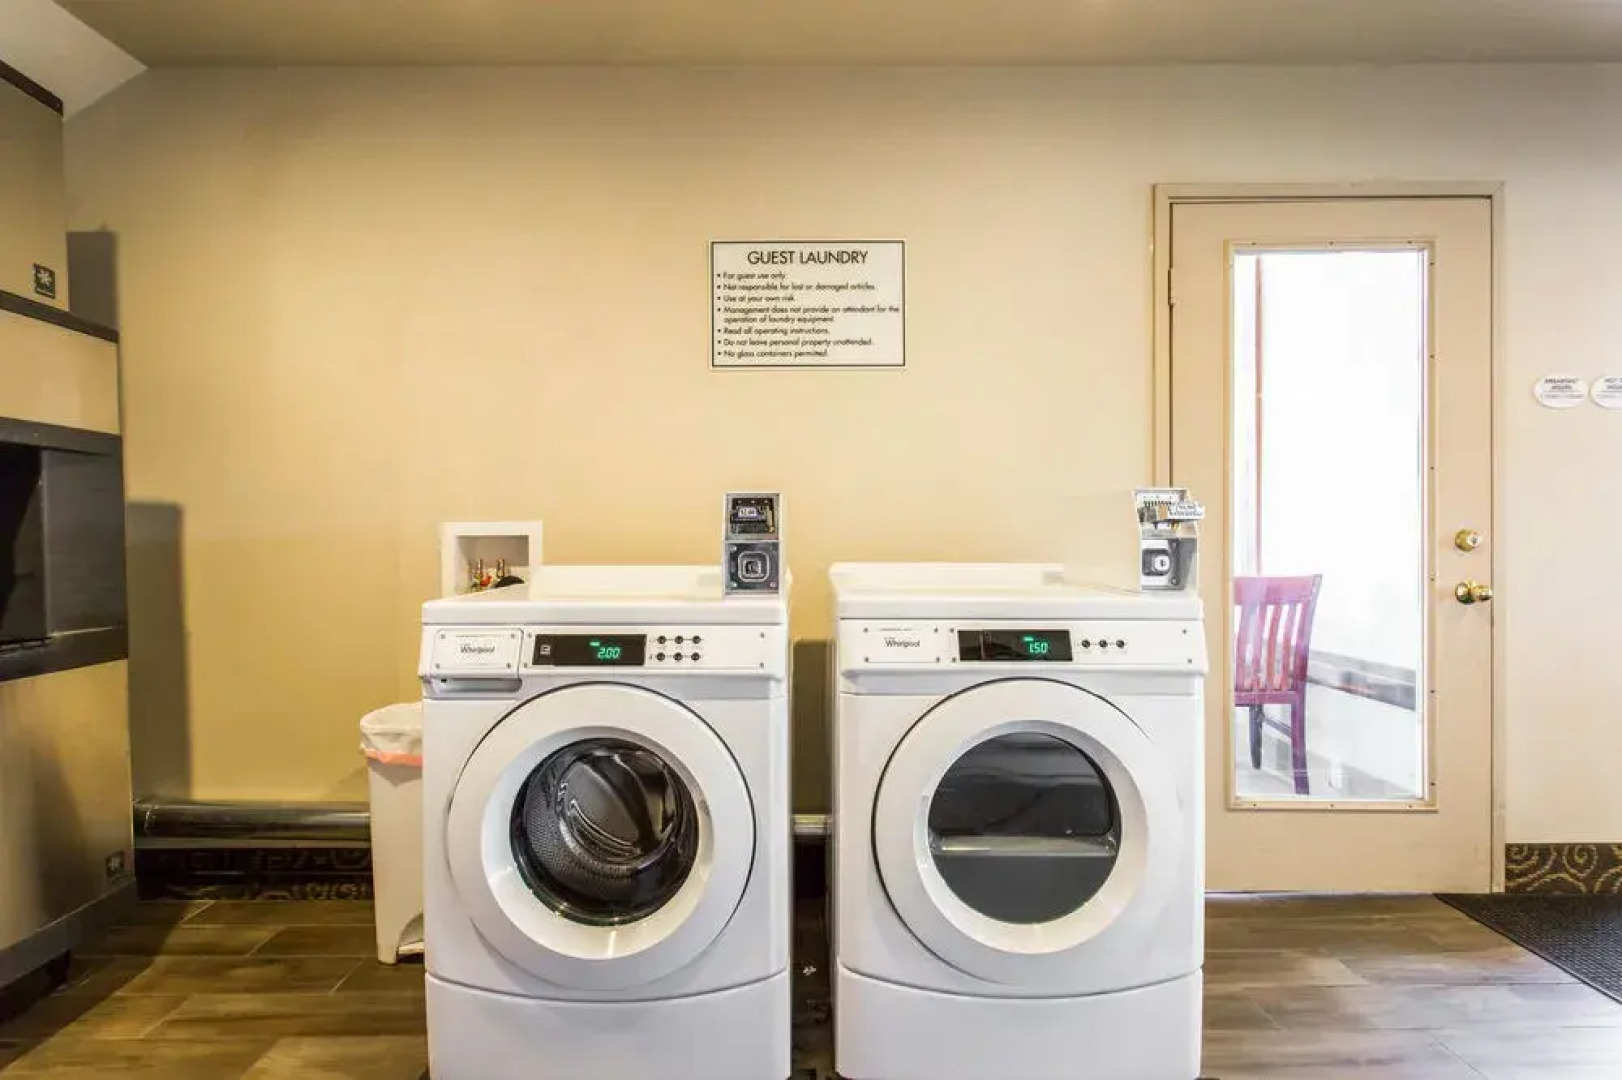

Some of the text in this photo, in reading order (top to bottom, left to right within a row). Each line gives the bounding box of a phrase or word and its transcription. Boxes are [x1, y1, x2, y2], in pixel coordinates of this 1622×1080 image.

[747, 250, 868, 265] GUEST LAUNDRY
[723, 271, 735, 279] For
[736, 272, 756, 281] guest
[723, 282, 737, 290] Not
[738, 282, 778, 292] responsible
[779, 282, 789, 290] for
[791, 282, 804, 290] lost
[815, 281, 849, 292] damaged
[723, 294, 736, 302] Use
[723, 306, 770, 315] Management
[771, 305, 788, 313] does
[802, 305, 829, 315] provide
[842, 305, 875, 313] attendant
[877, 304, 887, 313] for
[888, 305, 900, 313] the
[723, 317, 758, 325] operation
[758, 315, 767, 323] of
[769, 315, 796, 325] laundry
[723, 326, 742, 334] Read
[743, 326, 752, 334] all
[754, 327, 788, 336] operating
[723, 338, 735, 346] Do
[736, 338, 747, 346] not
[748, 337, 767, 346] leave
[768, 337, 800, 347] personal
[801, 338, 831, 348] property
[723, 349, 735, 357] No
[737, 349, 755, 360] glass
[756, 350, 793, 358] containers
[885, 639, 920, 649] Whirlpool
[460, 645, 495, 655] Whirlpool
